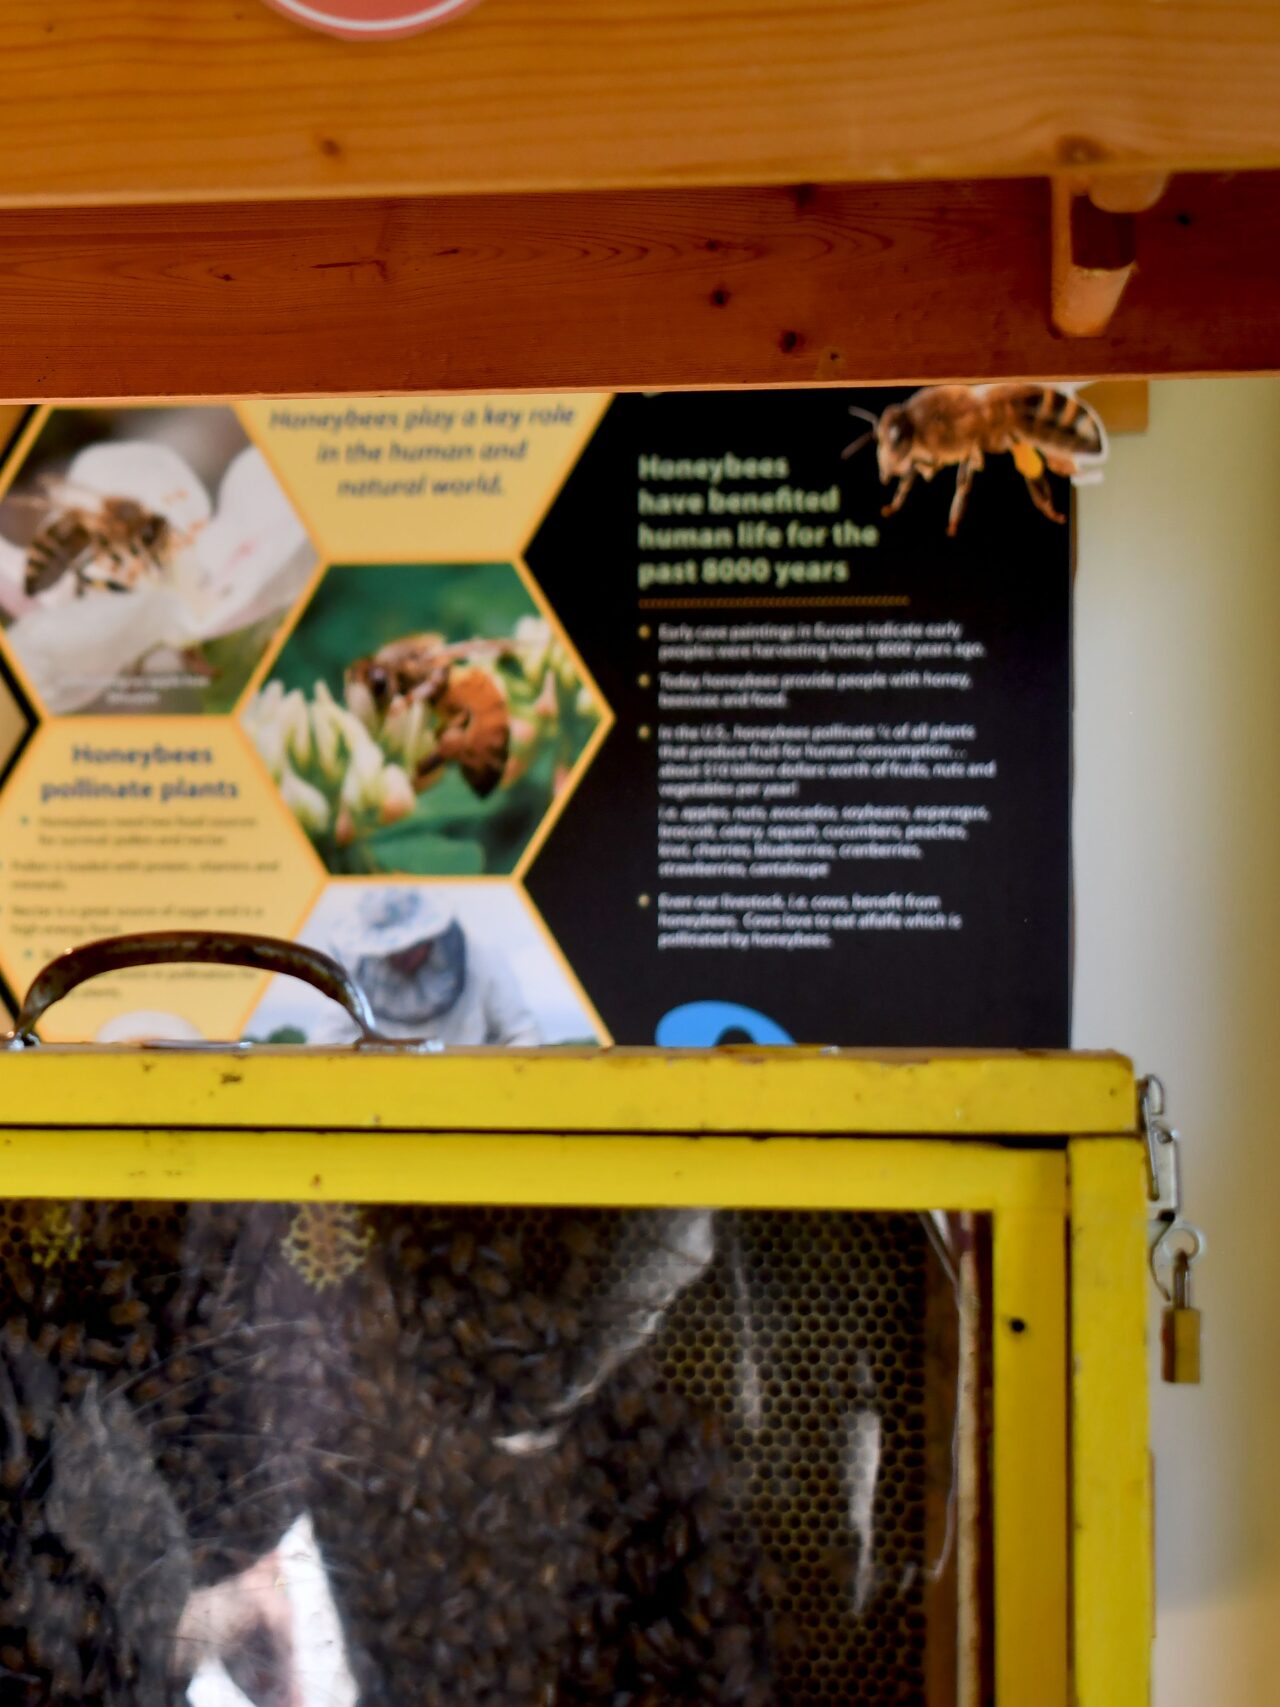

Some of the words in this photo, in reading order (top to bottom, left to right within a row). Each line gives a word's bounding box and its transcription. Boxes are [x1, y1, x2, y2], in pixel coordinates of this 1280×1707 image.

[268, 407, 398, 434] Honeybees
[404, 406, 454, 433] play
[461, 411, 476, 427] a
[482, 403, 521, 432] key
[528, 402, 574, 425] role
[317, 440, 340, 463] in
[345, 439, 381, 463] the
[388, 440, 473, 463] human
[479, 438, 528, 462] and
[639, 453, 789, 484] Honeybees
[336, 473, 427, 498] natural
[431, 471, 504, 497] world.
[639, 489, 704, 515] have
[709, 487, 841, 513] benefited
[639, 524, 733, 550] human
[737, 522, 782, 548] life
[787, 522, 827, 547] for
[833, 520, 879, 547] the
[639, 560, 697, 590] past
[702, 558, 771, 583] 8000
[775, 562, 849, 588] years
[72, 741, 213, 770] Honeybees
[41, 776, 153, 804] pollinate
[160, 775, 239, 804] plants
